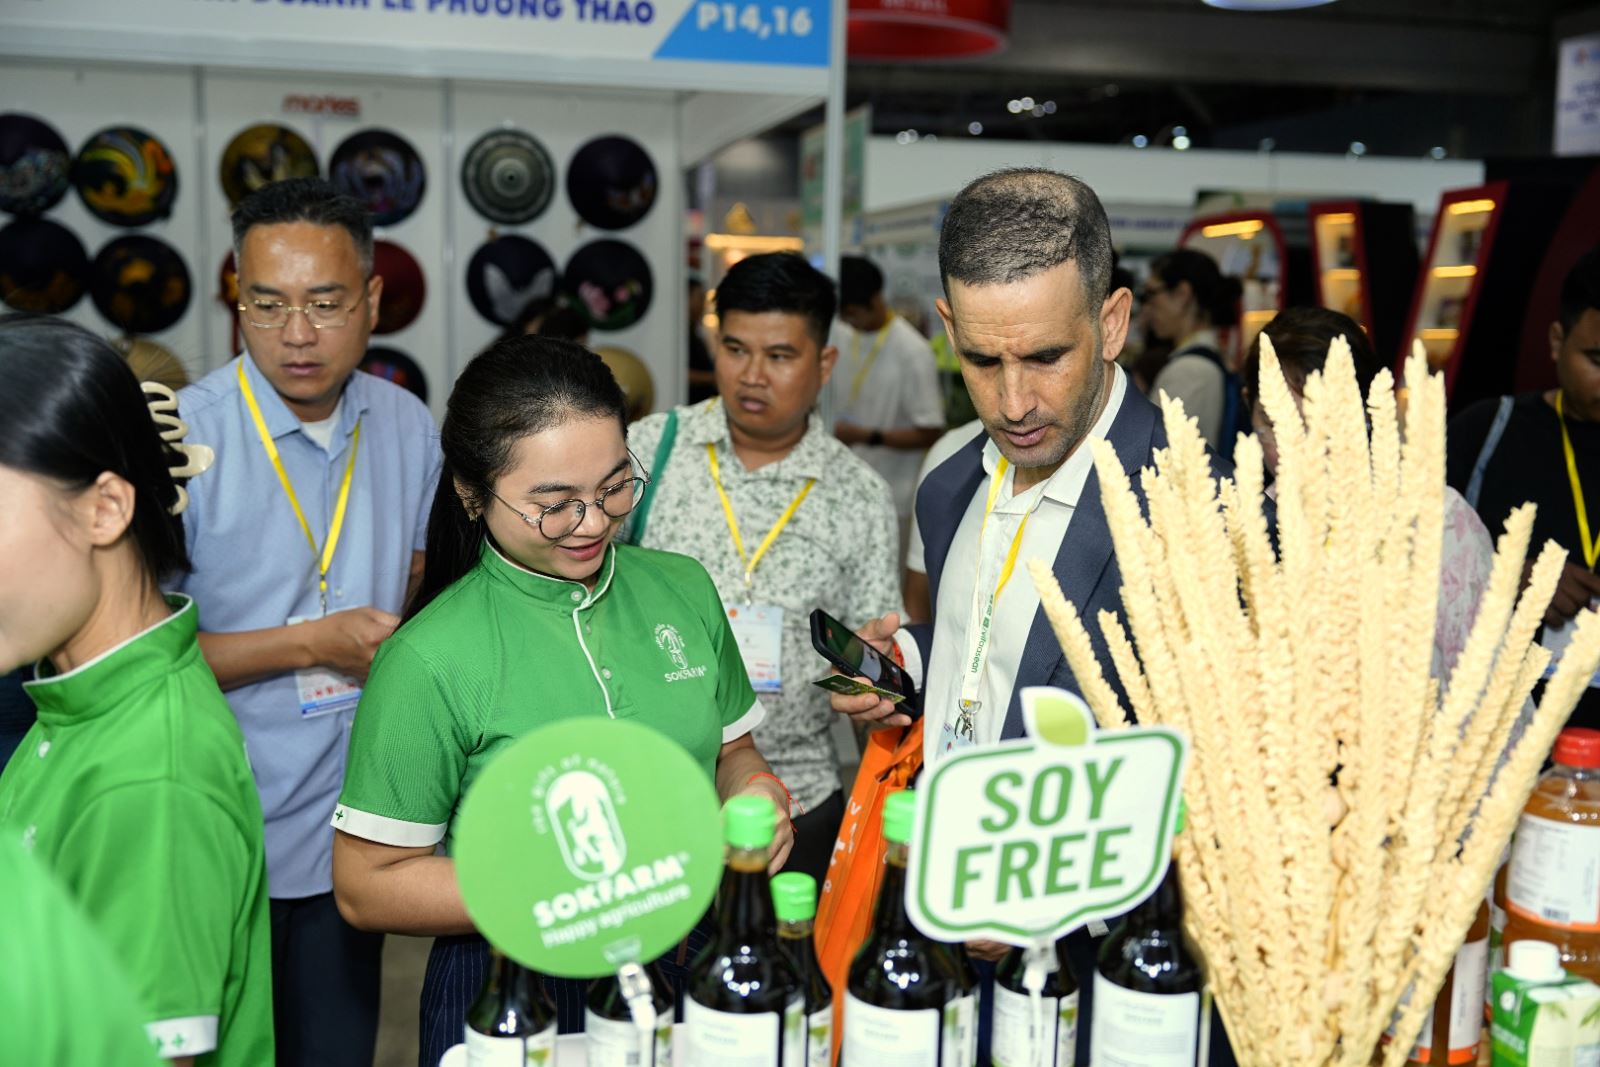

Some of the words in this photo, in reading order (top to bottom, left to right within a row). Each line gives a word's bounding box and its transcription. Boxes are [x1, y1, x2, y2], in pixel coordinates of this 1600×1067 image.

[696, 3, 813, 38] P14,16
[980, 756, 1125, 833] SOY
[952, 825, 1132, 910] FREE
